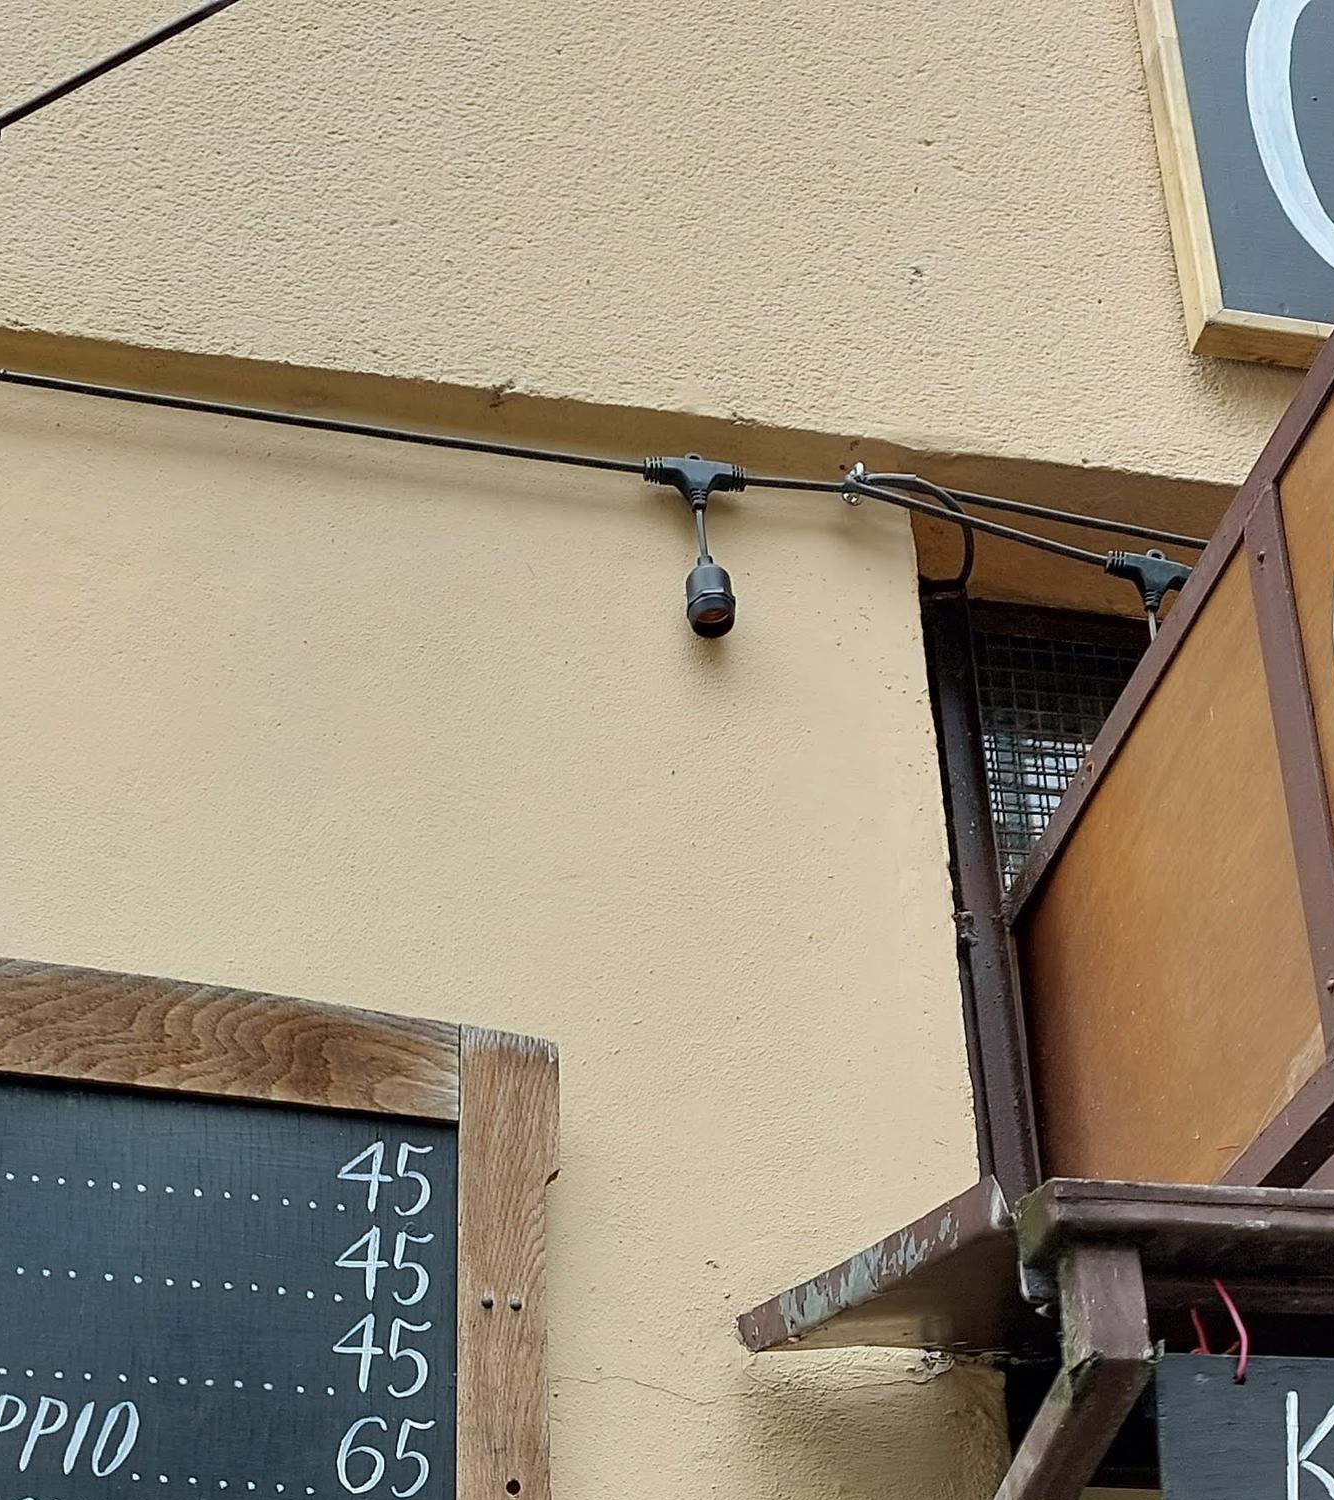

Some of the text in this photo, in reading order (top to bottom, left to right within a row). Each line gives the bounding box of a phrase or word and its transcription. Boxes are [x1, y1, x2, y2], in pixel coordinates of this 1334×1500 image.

[336, 1141, 433, 1216] 45
[334, 1225, 434, 1305] 45
[332, 1313, 431, 1397] 45
[336, 1417, 434, 1497] 65
